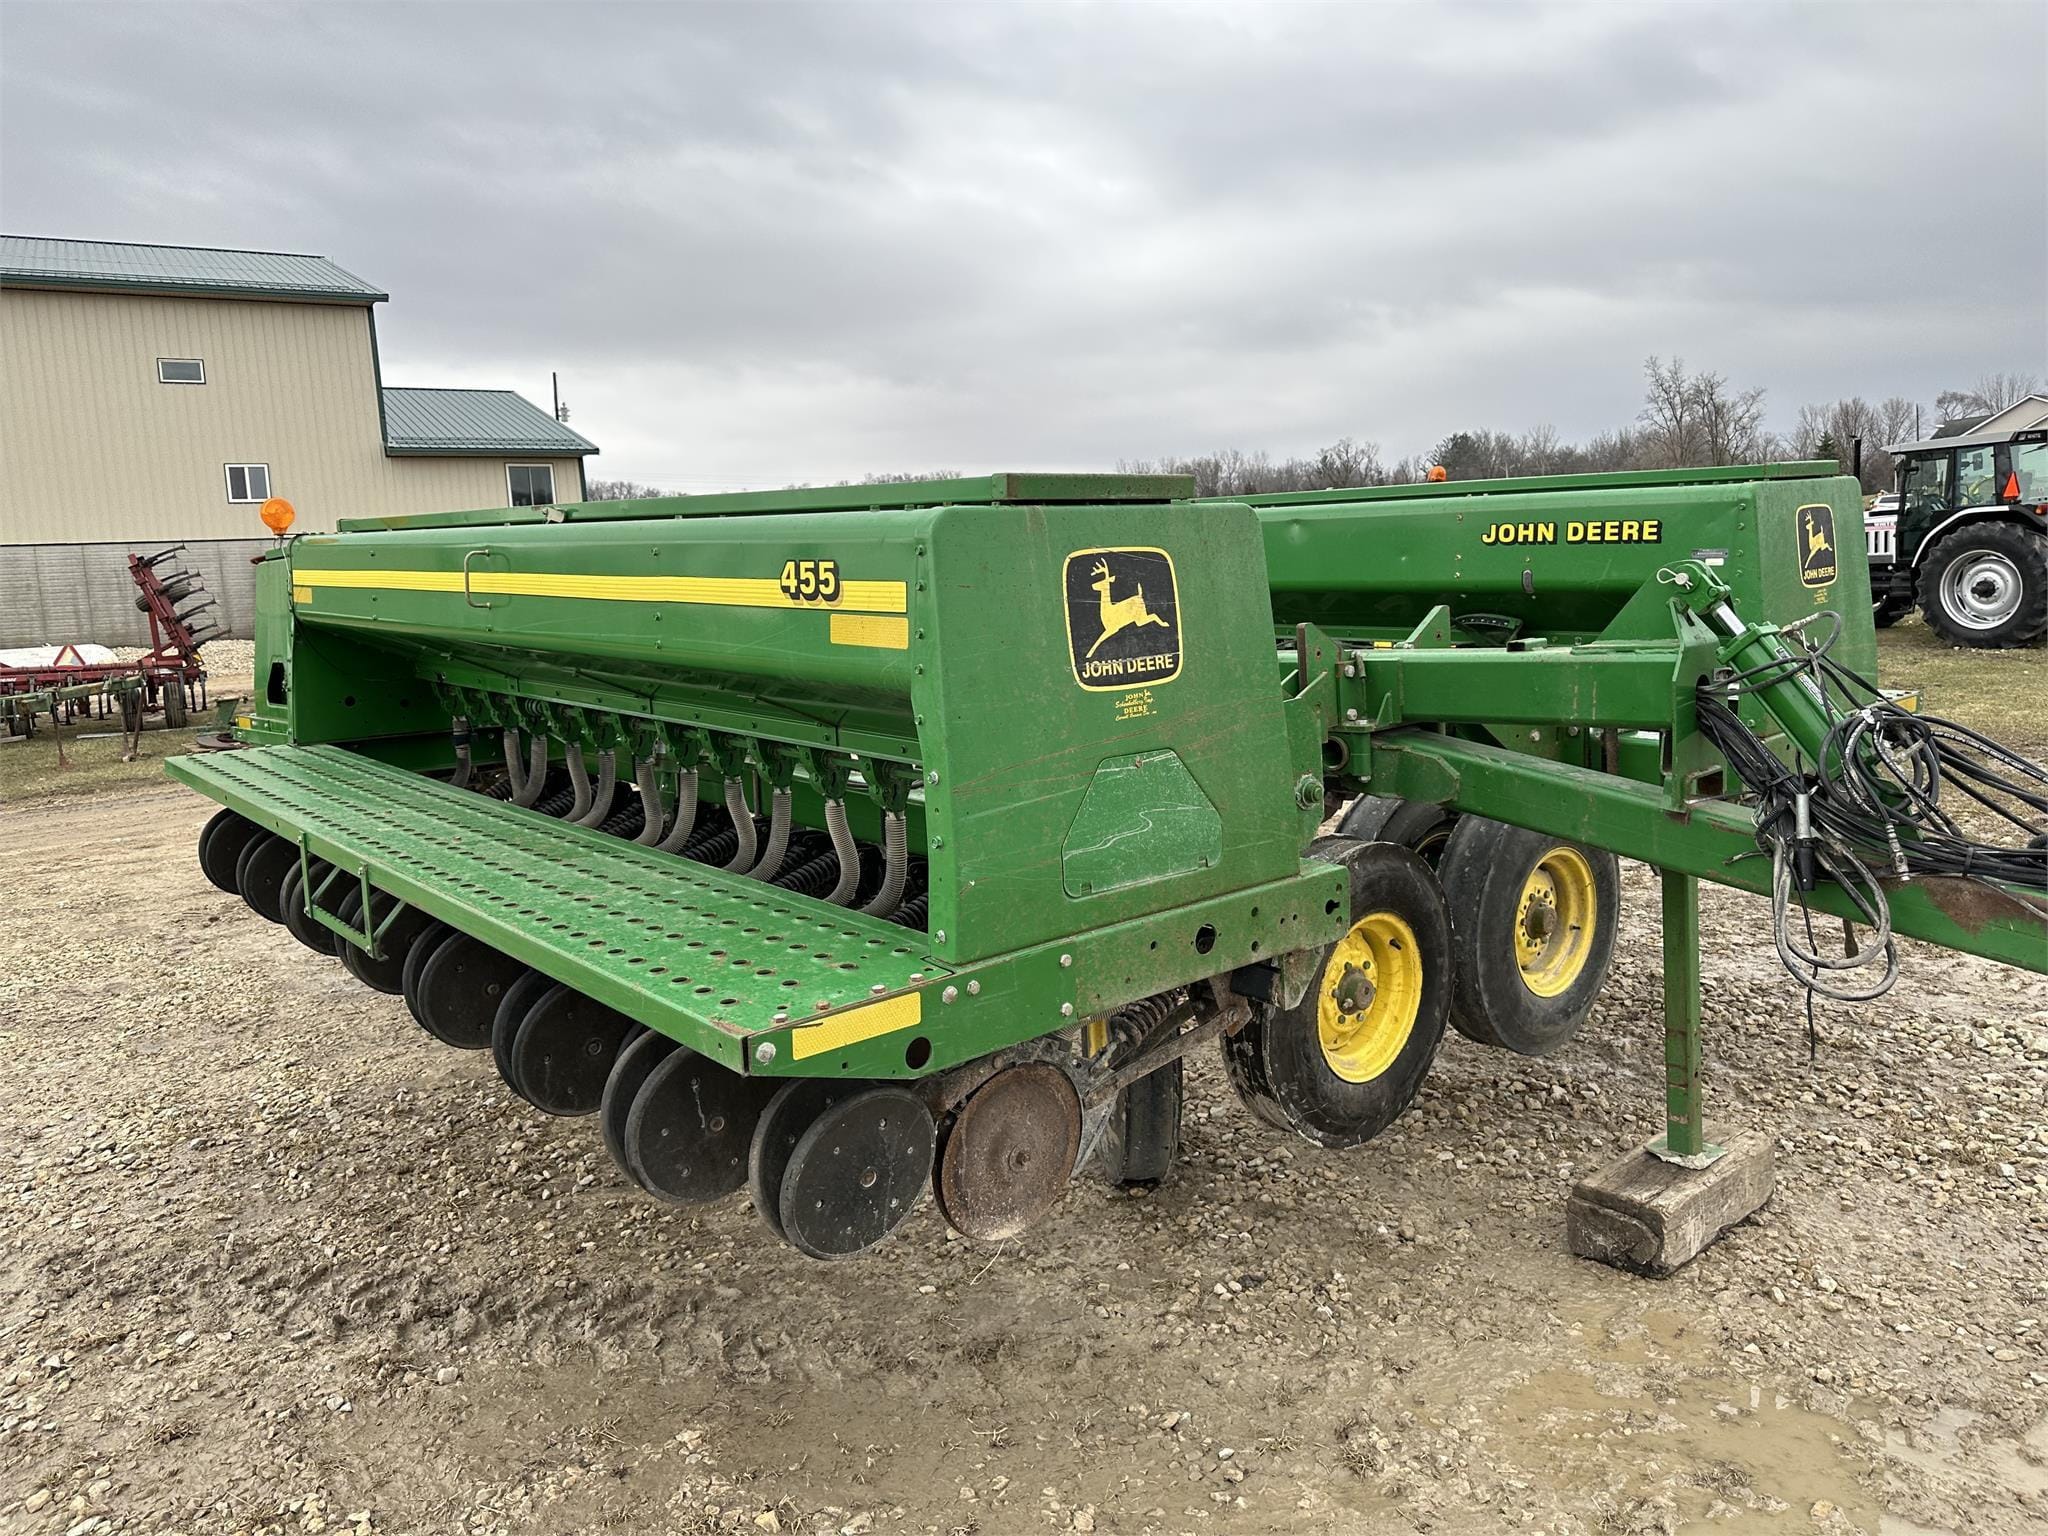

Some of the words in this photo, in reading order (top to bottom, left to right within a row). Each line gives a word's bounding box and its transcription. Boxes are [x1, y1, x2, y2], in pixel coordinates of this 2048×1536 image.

[1482, 522, 1555, 544] JOHN
[1566, 520, 1661, 543] DEERE
[780, 560, 839, 600] 455
[1803, 569, 1818, 580] JOHN
[1818, 566, 1834, 577] DEERE
[1082, 658, 1123, 678] JOHN
[1126, 654, 1174, 673] DEERE
